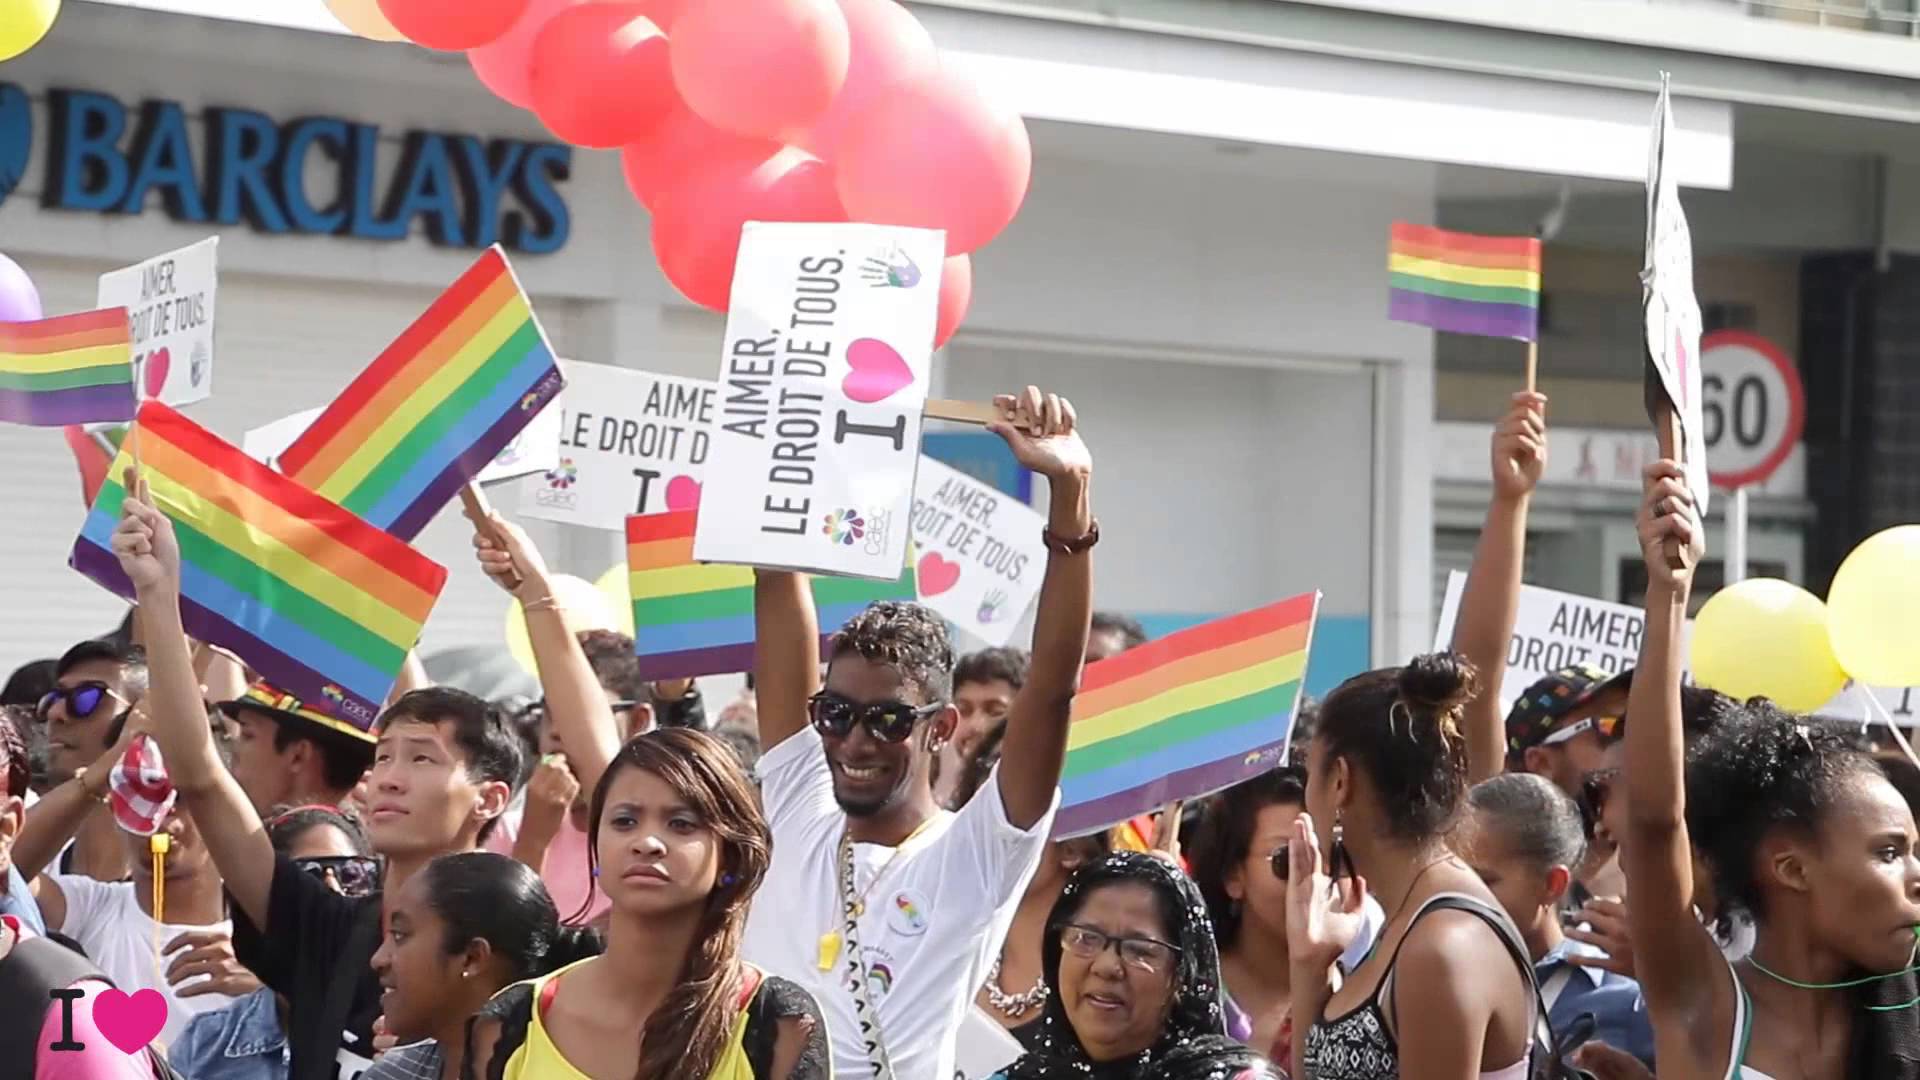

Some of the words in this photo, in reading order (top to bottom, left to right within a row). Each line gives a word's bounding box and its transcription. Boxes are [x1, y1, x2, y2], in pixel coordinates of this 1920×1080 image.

[42, 88, 571, 255] BARCLAYS
[791, 249, 846, 329] TOUS.
[154, 300, 171, 338] DE
[721, 329, 782, 439] AIMER,
[783, 339, 831, 377] DE
[643, 381, 717, 424] AIME
[834, 409, 906, 451] I
[1702, 373, 1768, 450] 60
[560, 409, 592, 448] LE
[598, 416, 685, 466] DROIT
[690, 431, 710, 465] D
[769, 388, 824, 485] DROIT
[761, 495, 810, 536] LE
[912, 500, 953, 539] ROIT
[946, 522, 981, 556] DE
